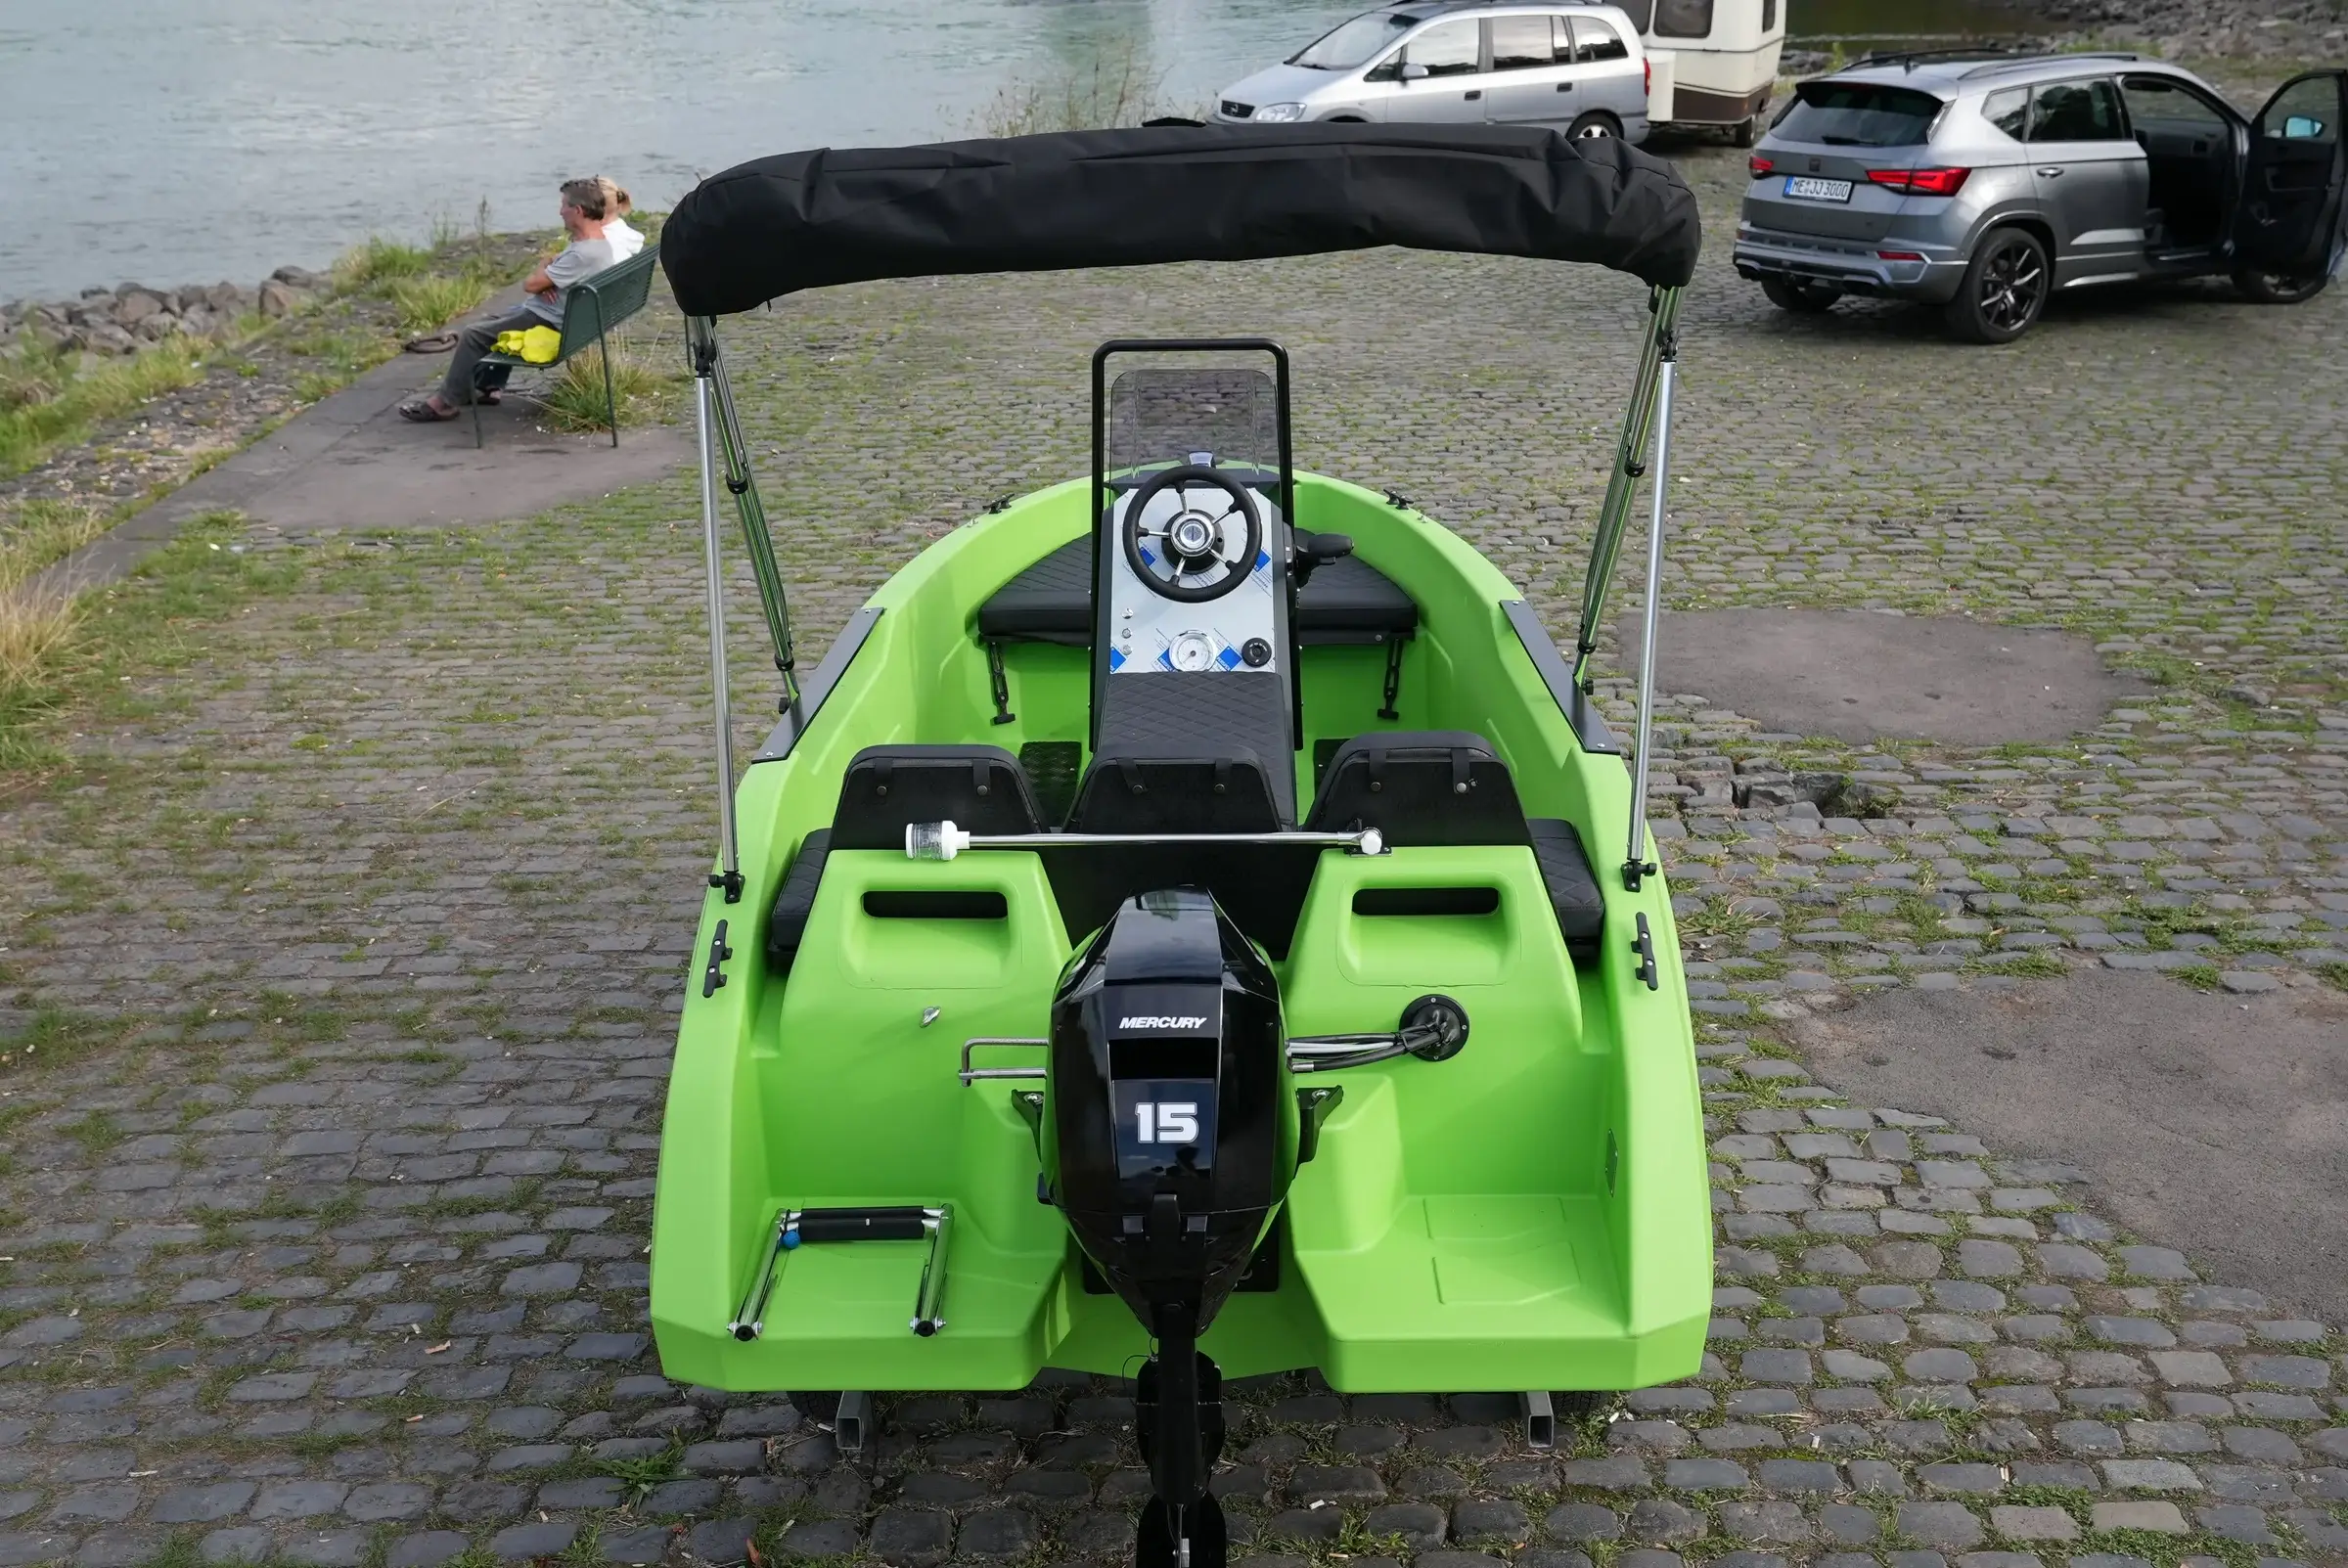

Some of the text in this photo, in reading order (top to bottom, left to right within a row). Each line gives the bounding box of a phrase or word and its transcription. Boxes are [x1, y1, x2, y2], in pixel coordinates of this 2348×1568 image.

[1824, 182, 1848, 197] 3000
[1118, 1015, 1208, 1029] MERCURY
[1135, 1101, 1199, 1143] 15
